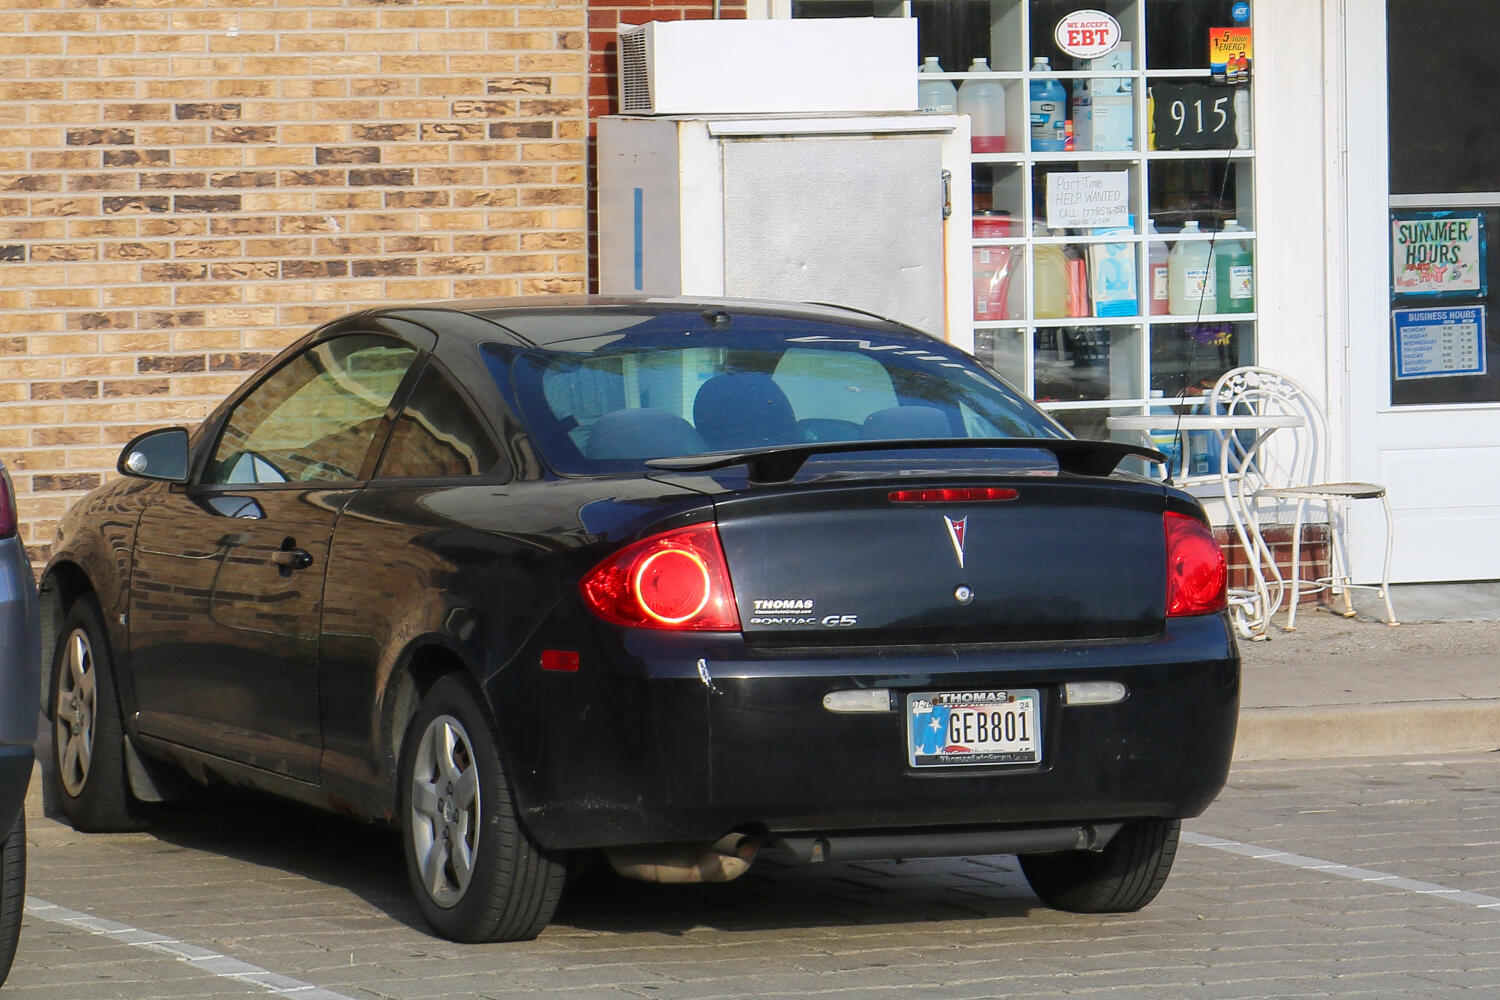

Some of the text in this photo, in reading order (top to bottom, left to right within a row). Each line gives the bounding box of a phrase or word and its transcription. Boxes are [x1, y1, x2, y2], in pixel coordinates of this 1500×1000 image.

[1067, 29, 1109, 46] EBT
[1219, 43, 1247, 51] ENERGY
[1171, 97, 1228, 136] 915
[1056, 190, 1121, 206] HELP WANTED
[1059, 208, 1076, 218] CALL
[1398, 222, 1468, 244] SUMMER
[1406, 244, 1461, 264] HOURS
[1408, 310, 1476, 322] BUSINESS HOURS
[754, 600, 813, 609] THOMAS
[750, 614, 858, 628] PONTIAC G5
[940, 692, 1007, 703] THOMAS
[950, 711, 1030, 743] GEB801
